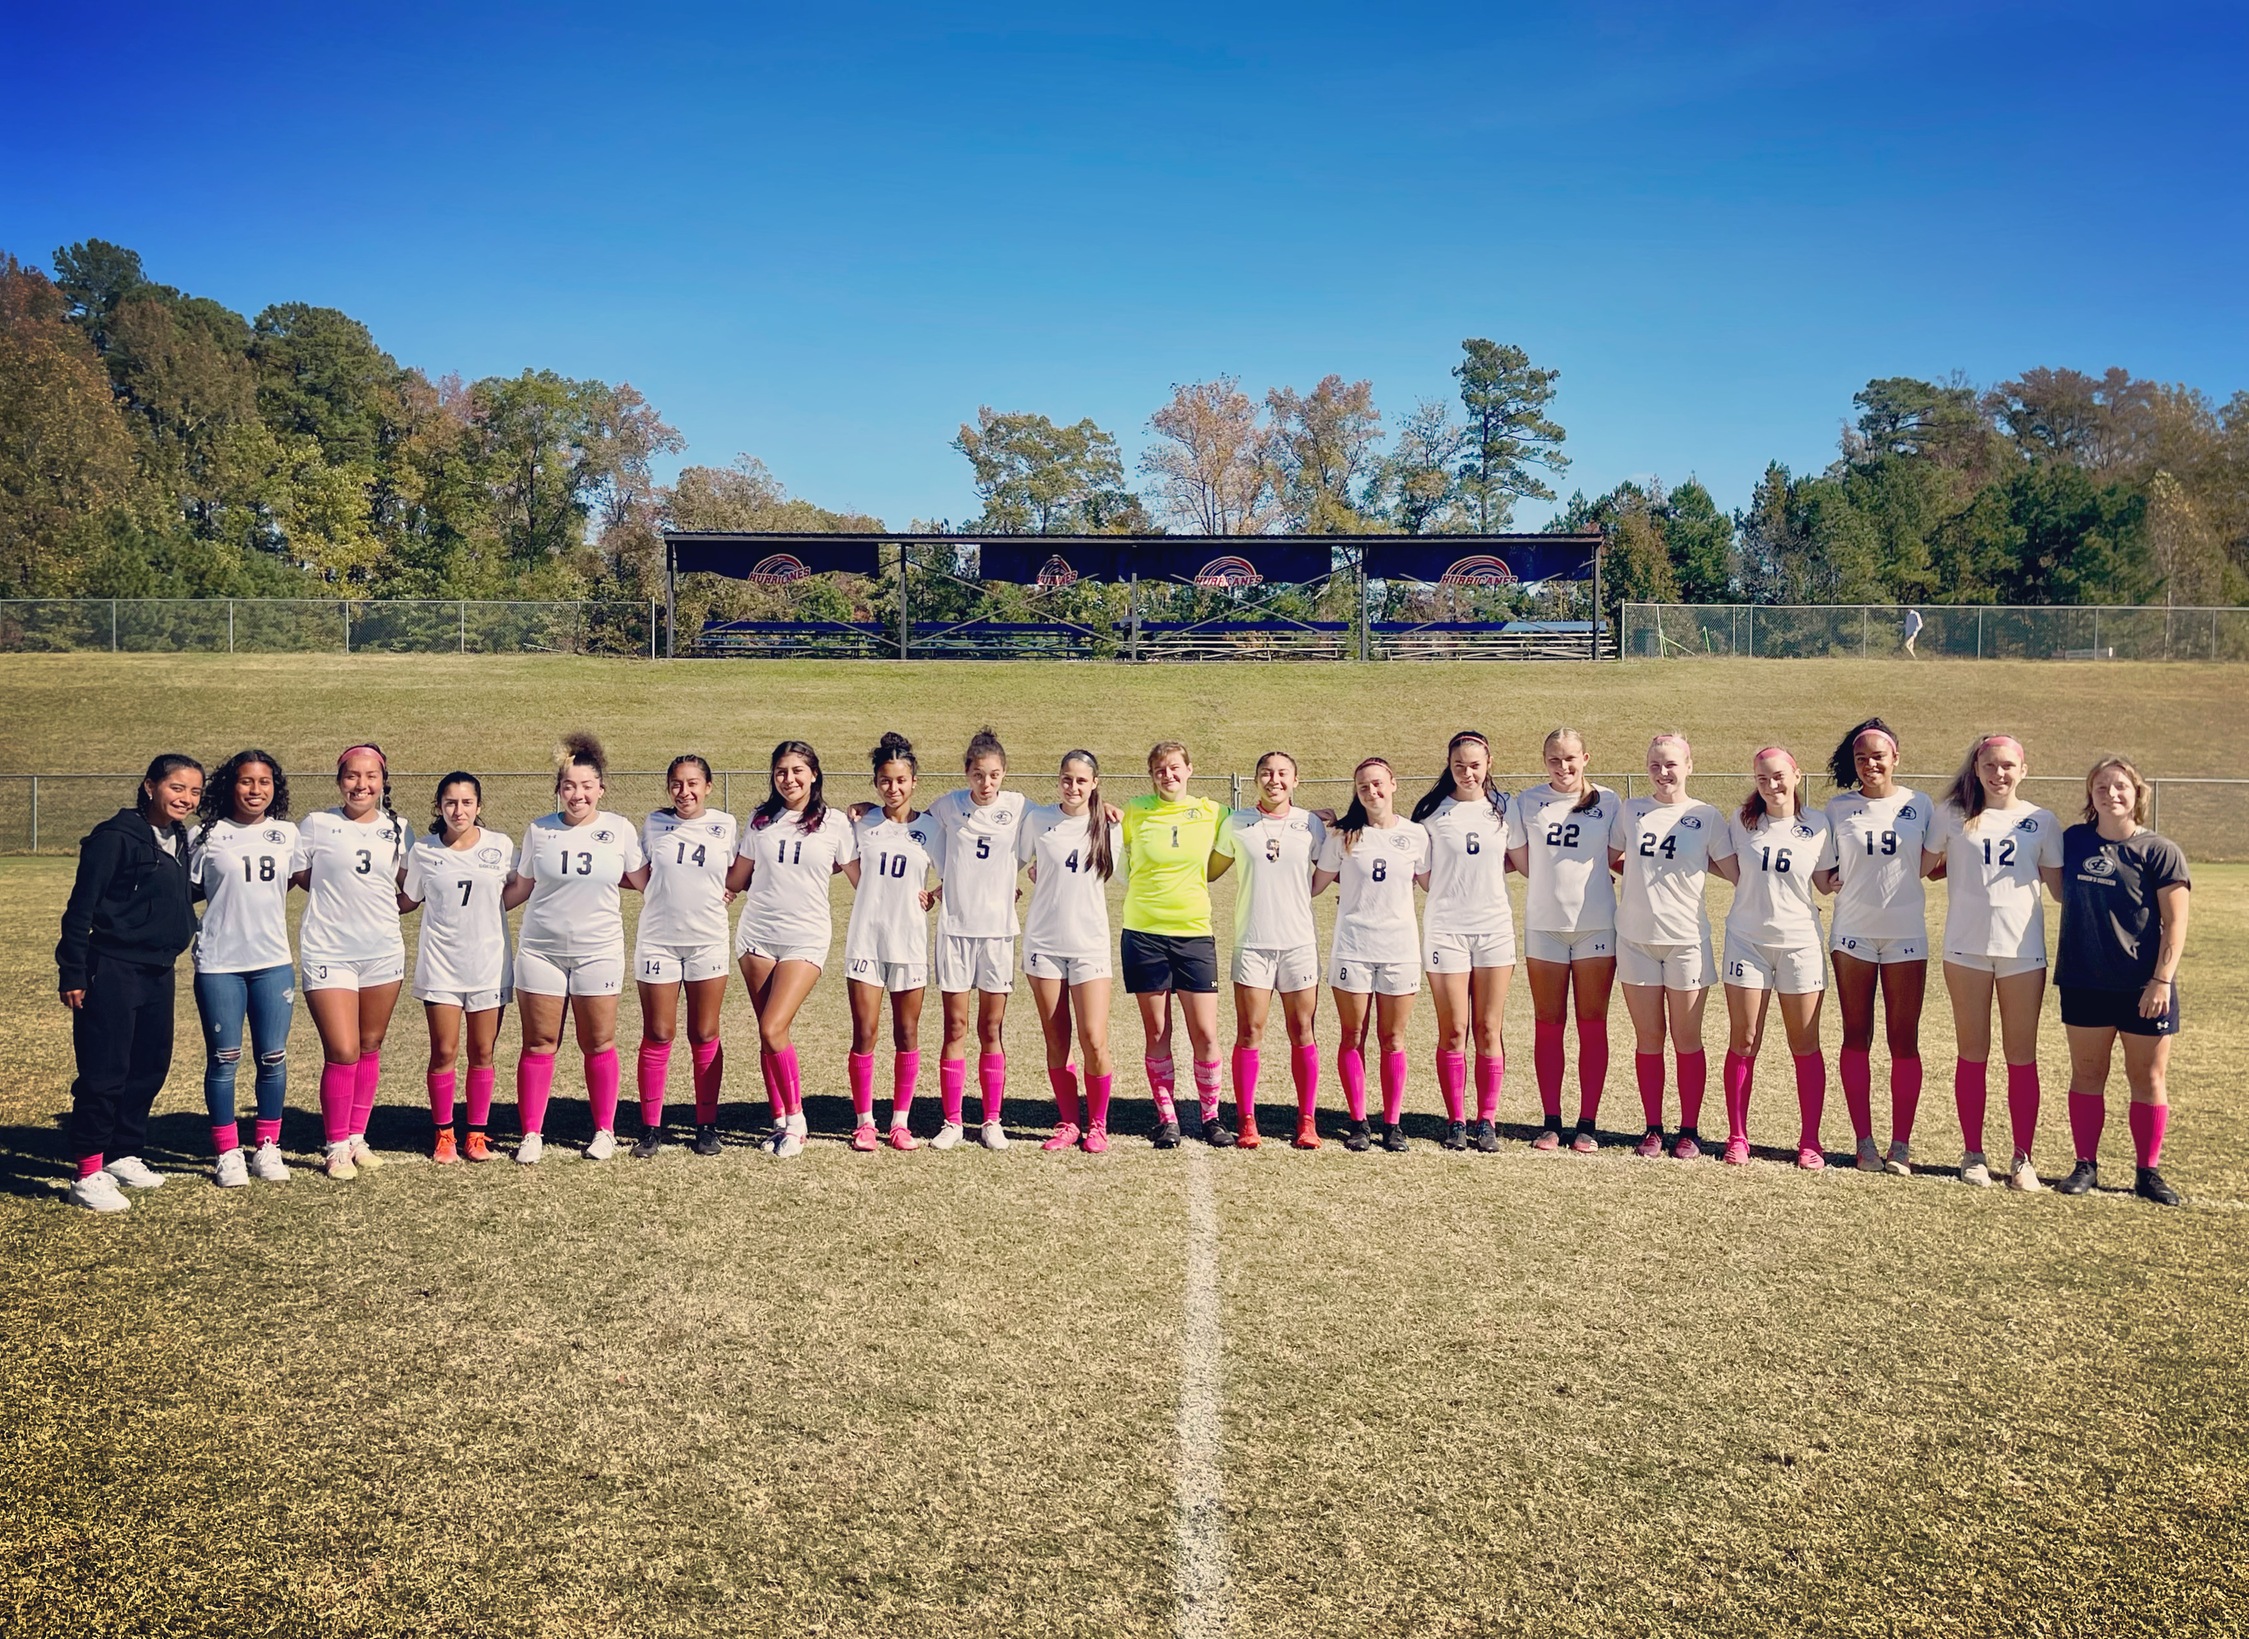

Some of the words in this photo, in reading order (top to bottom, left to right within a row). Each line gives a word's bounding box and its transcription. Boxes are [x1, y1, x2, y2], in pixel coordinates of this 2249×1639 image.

[976, 836, 991, 859] 5
[1171, 826, 1179, 848] 1
[1466, 831, 1480, 855] 6
[1546, 822, 1580, 848] 22
[1640, 832, 1677, 861] 24
[1864, 830, 1897, 856] 19
[355, 849, 372, 874] 3
[561, 850, 593, 875] 13
[677, 842, 706, 867] 14
[778, 839, 802, 864] 11
[1065, 848, 1079, 873] 4
[1266, 838, 1281, 863] 9
[1761, 846, 1792, 873] 16
[1982, 838, 2015, 866] 12
[242, 855, 275, 882] 18
[879, 851, 907, 878] 10
[1372, 857, 1387, 882] 8
[457, 880, 473, 906] 7
[645, 960, 660, 975] 14
[853, 959, 868, 973] 10
[1030, 953, 1038, 967] 4
[1432, 951, 1439, 965] 6
[1729, 960, 1743, 977] 16
[319, 966, 328, 979] 3
[1340, 967, 1347, 980] 8
